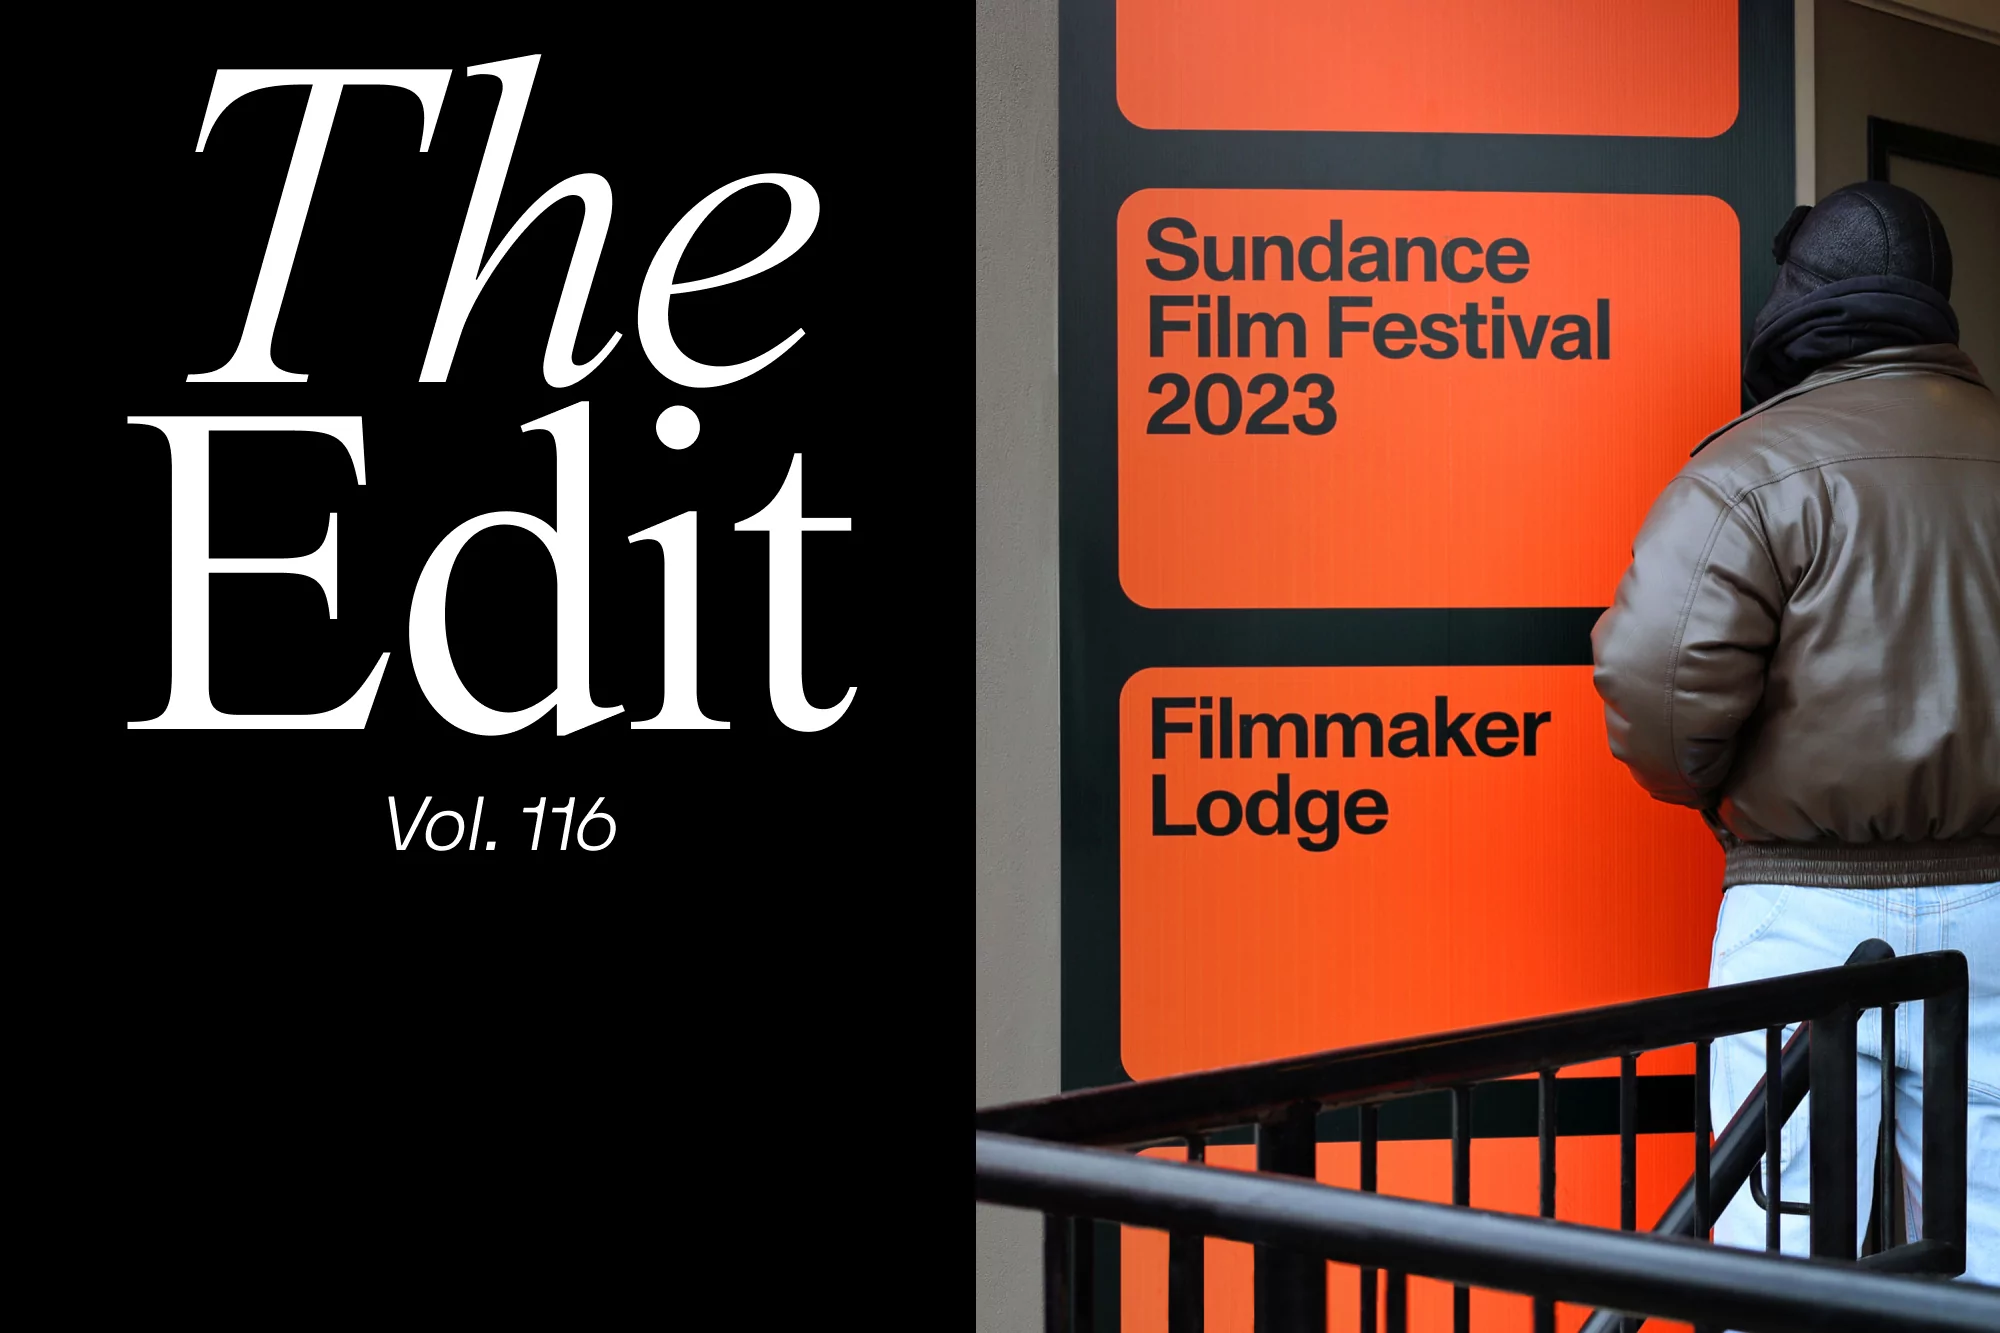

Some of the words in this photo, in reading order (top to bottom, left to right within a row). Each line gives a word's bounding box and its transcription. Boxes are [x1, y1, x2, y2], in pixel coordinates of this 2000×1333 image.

[1146, 218, 1529, 283] Sundance
[1150, 296, 1306, 357] Film
[1329, 296, 1609, 360] Festival
[1147, 373, 1336, 435] 2023
[1152, 696, 1551, 759] Filmmaker
[1153, 774, 1388, 852] Lodge
